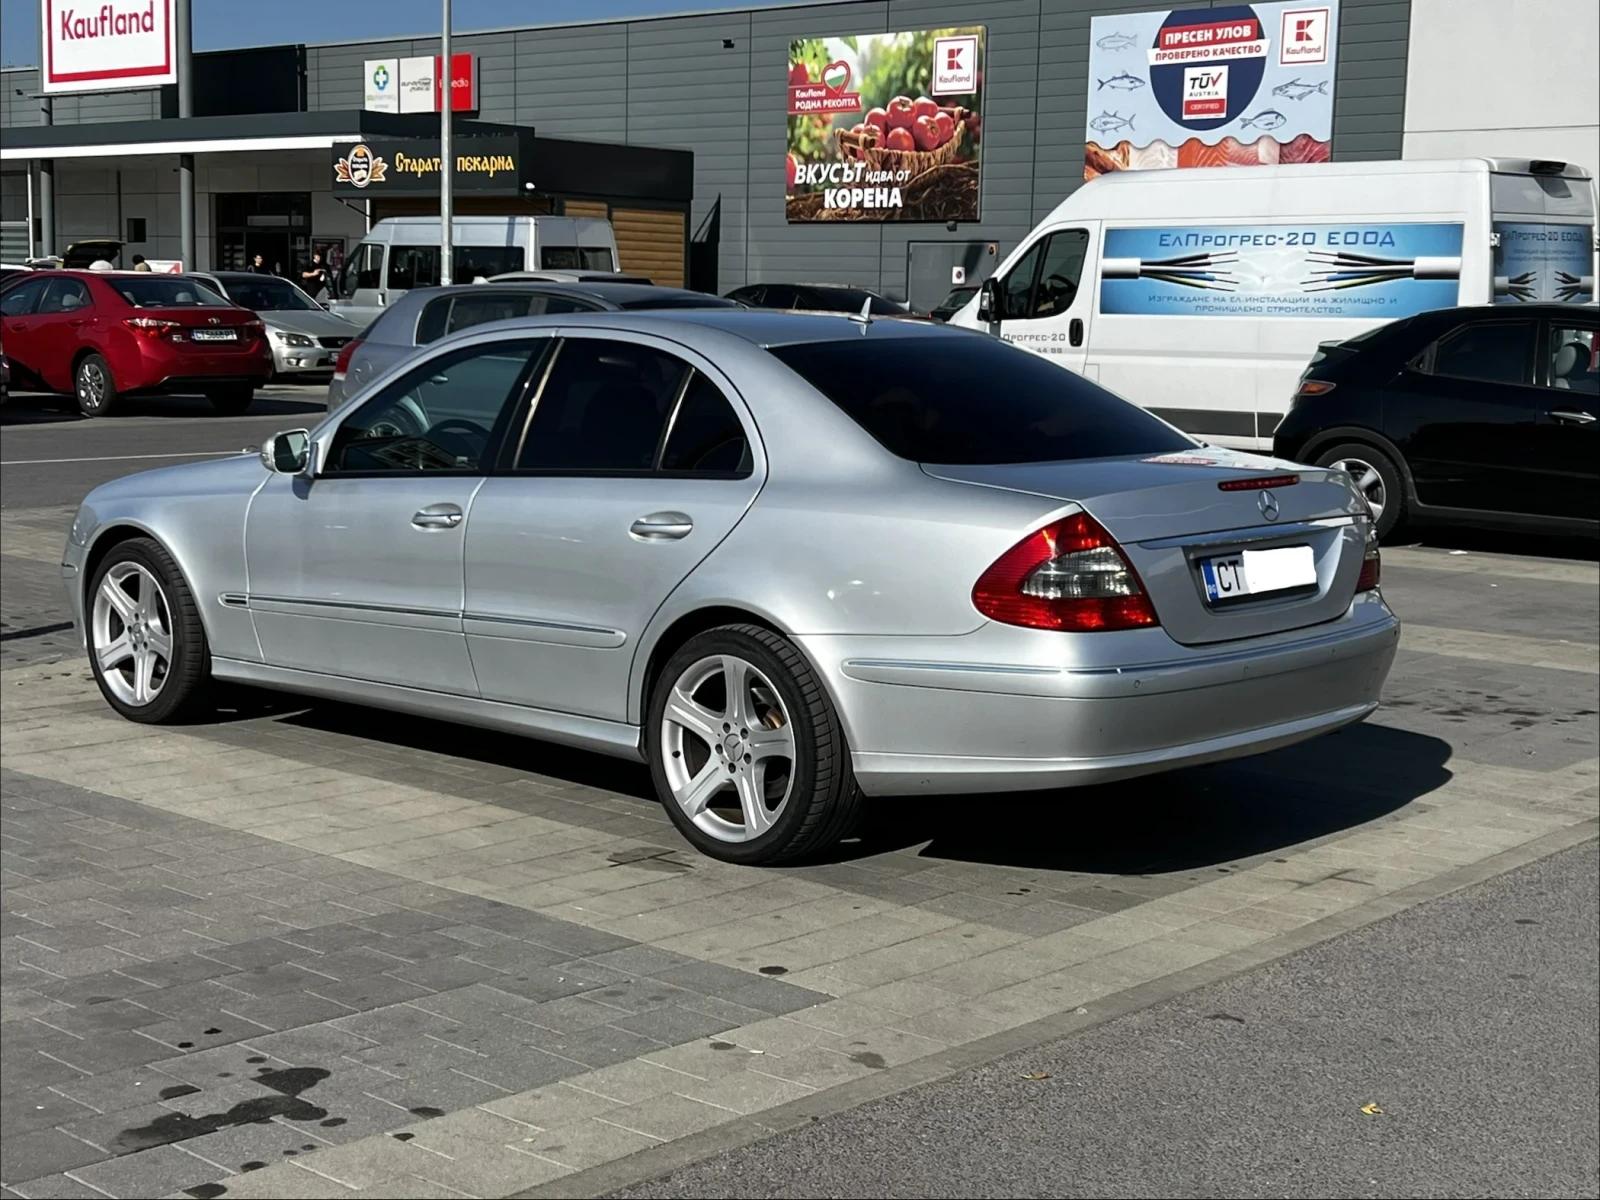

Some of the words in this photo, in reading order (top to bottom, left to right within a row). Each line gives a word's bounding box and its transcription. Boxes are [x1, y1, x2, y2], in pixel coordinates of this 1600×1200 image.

[61, 1, 155, 41] Kaufland
[1164, 29, 1213, 46] ПРЕСЕН
[1216, 24, 1252, 41] УЛОВ
[1155, 48, 1210, 62] ПРОВЕРЕНО
[1212, 44, 1262, 57] КАЧЕСТВО
[1286, 44, 1322, 56] Kaufland
[938, 74, 971, 84] Kaufland
[795, 88, 826, 99] Kaufland
[795, 100, 822, 111] РОДНА
[822, 97, 857, 108] РЕКОЛТА
[395, 152, 443, 178] Старат
[794, 162, 866, 185] ВКУСЪТ
[865, 170, 894, 184] ИДВА
[896, 170, 911, 182] ОТ
[824, 187, 904, 209] КОРЕНА
[1327, 231, 1396, 248] ЕООД
[1217, 560, 1241, 592] CT
